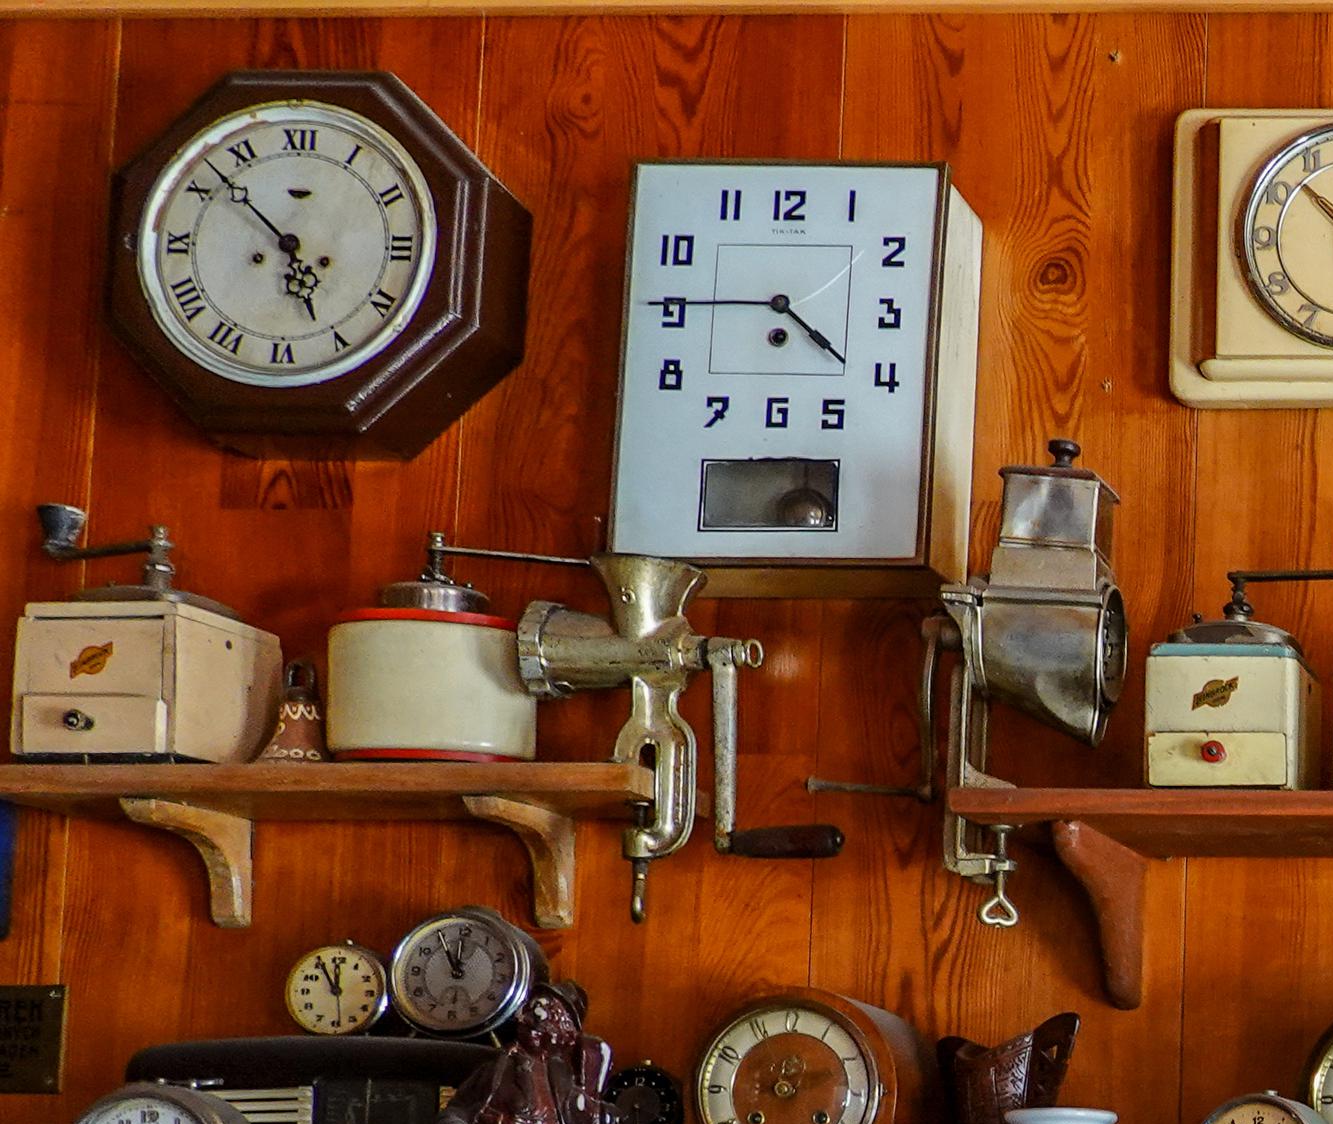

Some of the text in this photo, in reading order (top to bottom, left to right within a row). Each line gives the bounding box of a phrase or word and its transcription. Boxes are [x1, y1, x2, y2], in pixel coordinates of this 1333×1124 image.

[720, 190, 742, 220] 11
[773, 190, 806, 220] 12
[848, 190, 856, 222] 1
[660, 234, 694, 266] 10
[882, 236, 906, 267] 2
[878, 298, 901, 328] 3
[658, 359, 682, 390] 8
[874, 362, 900, 393] 4
[704, 396, 730, 428] 7
[821, 399, 846, 430] 5
